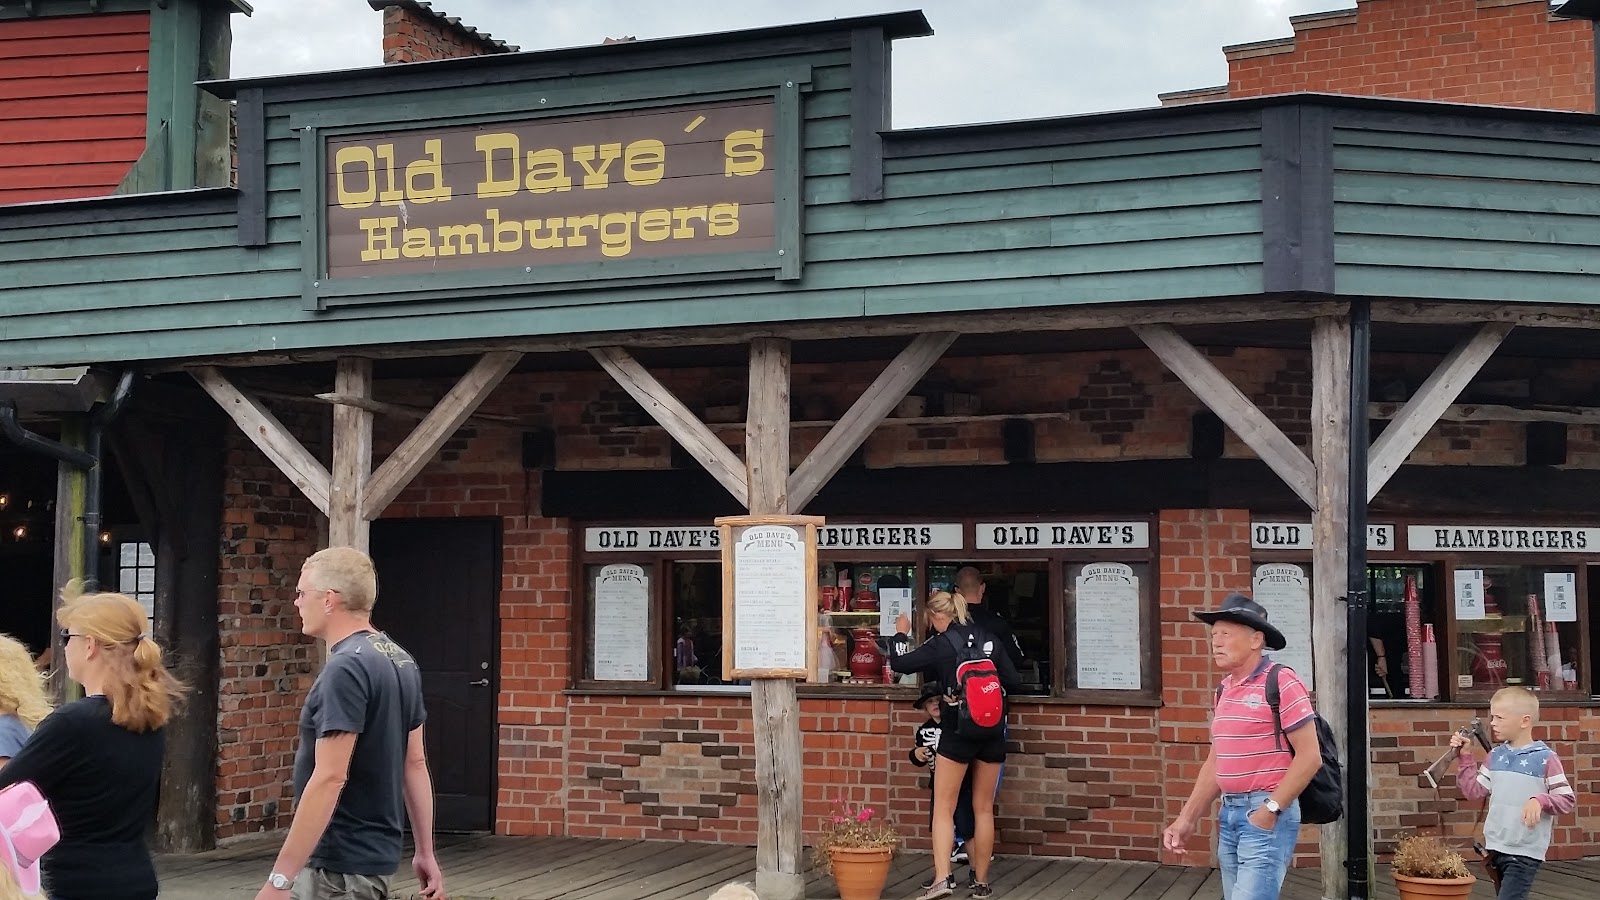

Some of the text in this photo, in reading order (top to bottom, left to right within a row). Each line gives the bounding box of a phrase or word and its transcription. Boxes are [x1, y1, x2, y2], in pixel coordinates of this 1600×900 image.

[335, 139, 452, 209] Old
[359, 203, 740, 262] Hamburgers
[598, 529, 720, 548] OLD DAVE'S
[748, 532, 791, 541] OLD DAVE'S
[757, 540, 783, 548] MENU
[816, 527, 932, 546] BURGERS
[993, 525, 1135, 545] OLD DAVE'S
[1255, 525, 1301, 545] OLD
[1434, 529, 1588, 549] HAMBURGERS
[1088, 567, 1126, 576] OLD DAVE'S
[1095, 574, 1119, 582] MENU
[1262, 569, 1275, 577] OLD
[1269, 575, 1291, 583] MENU
